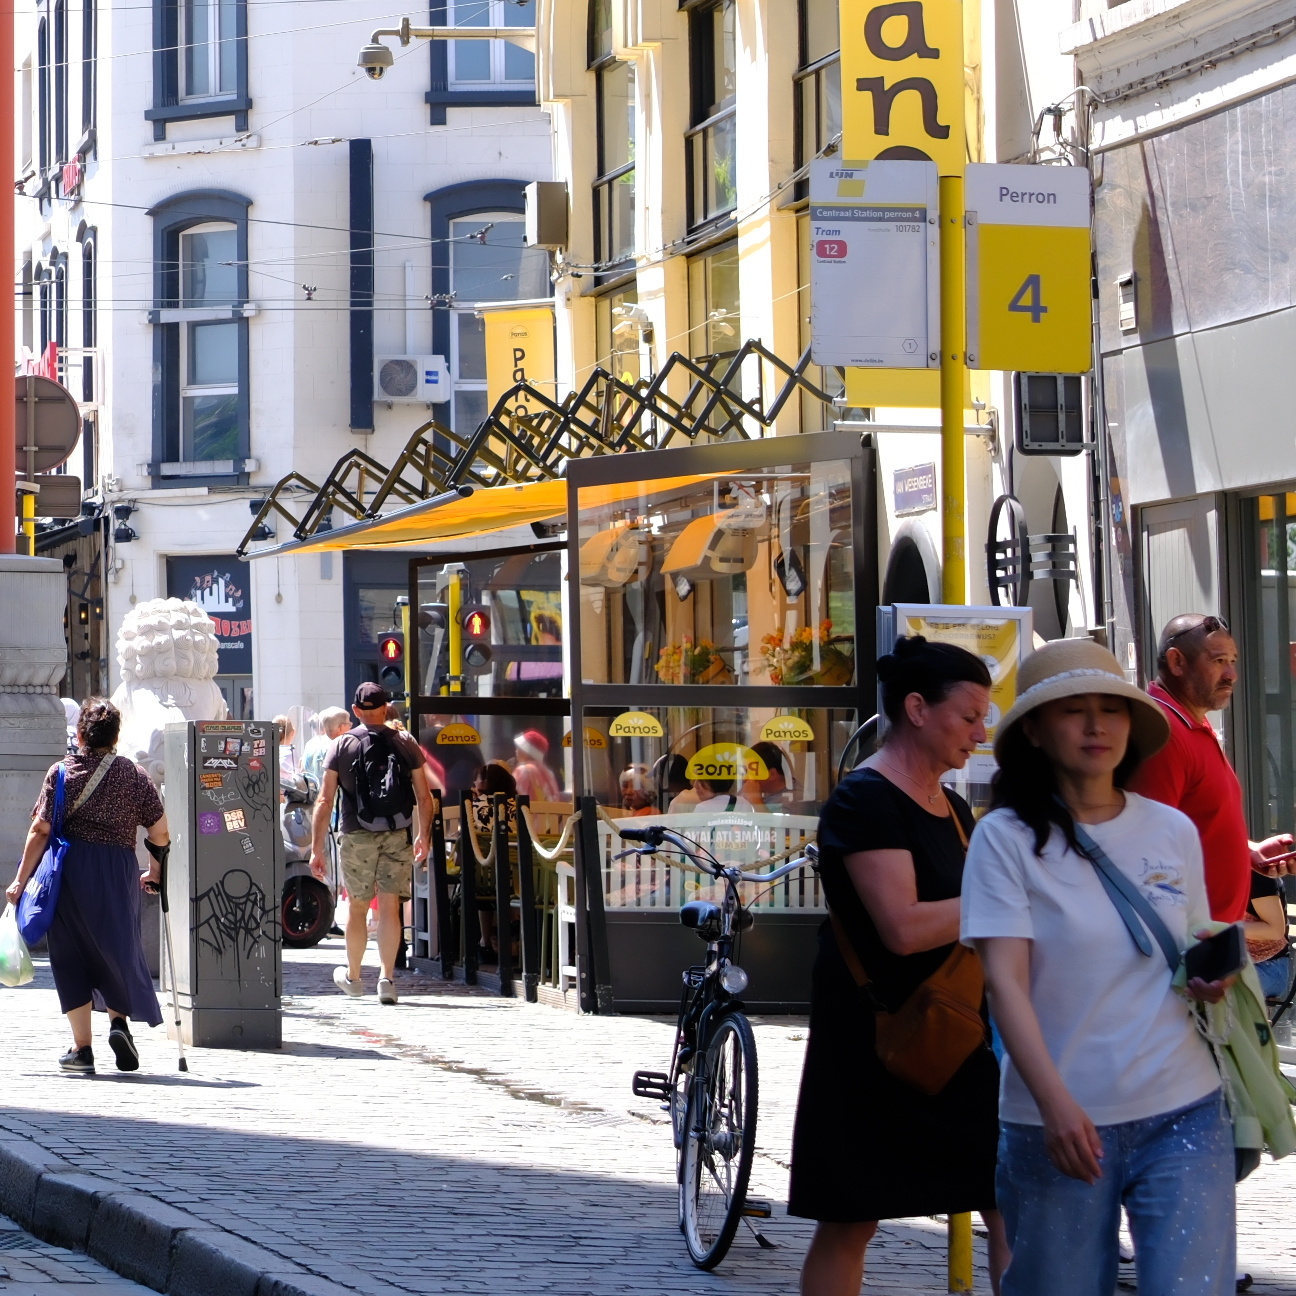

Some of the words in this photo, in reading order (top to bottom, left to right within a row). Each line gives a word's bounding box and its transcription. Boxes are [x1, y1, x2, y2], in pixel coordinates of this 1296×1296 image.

[998, 186, 1057, 205] Perron
[816, 208, 852, 217] Centraal
[853, 209, 883, 218] Station
[884, 211, 912, 219] perron
[913, 210, 920, 218] 4
[815, 226, 841, 237] Tram
[895, 224, 921, 233] 101782
[824, 243, 838, 255] 12
[1008, 273, 1048, 324] 4
[615, 723, 658, 735] Panos
[765, 728, 809, 739] Panos
[441, 733, 477, 743] Panos
[566, 737, 603, 747] Pnos
